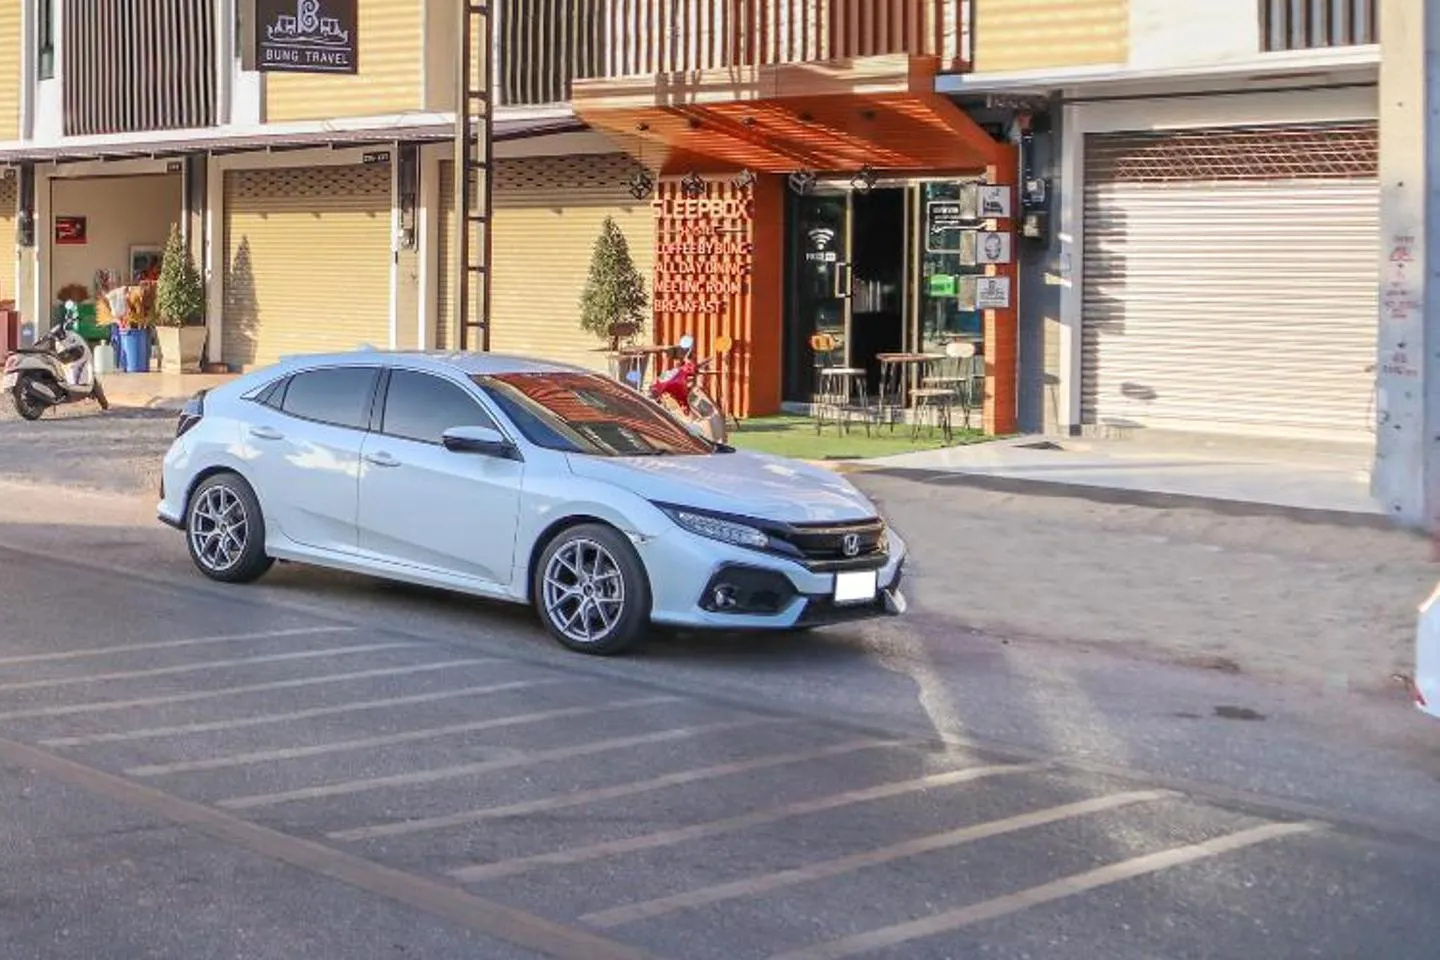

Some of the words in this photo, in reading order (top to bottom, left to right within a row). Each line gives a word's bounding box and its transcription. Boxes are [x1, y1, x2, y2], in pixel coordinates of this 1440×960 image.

[266, 48, 298, 62] BUNG
[305, 50, 348, 65] TRAVEL
[651, 199, 750, 219] SLEEPBOX
[656, 242, 698, 255] COFFEE
[698, 242, 714, 255] BY
[715, 241, 748, 255] BUNG
[657, 261, 678, 274] ALL
[679, 261, 704, 274] DAY
[705, 262, 747, 276] DINING
[655, 280, 705, 294] MEETING
[706, 281, 740, 295] ROOM
[655, 300, 721, 314] BREAKFAST
